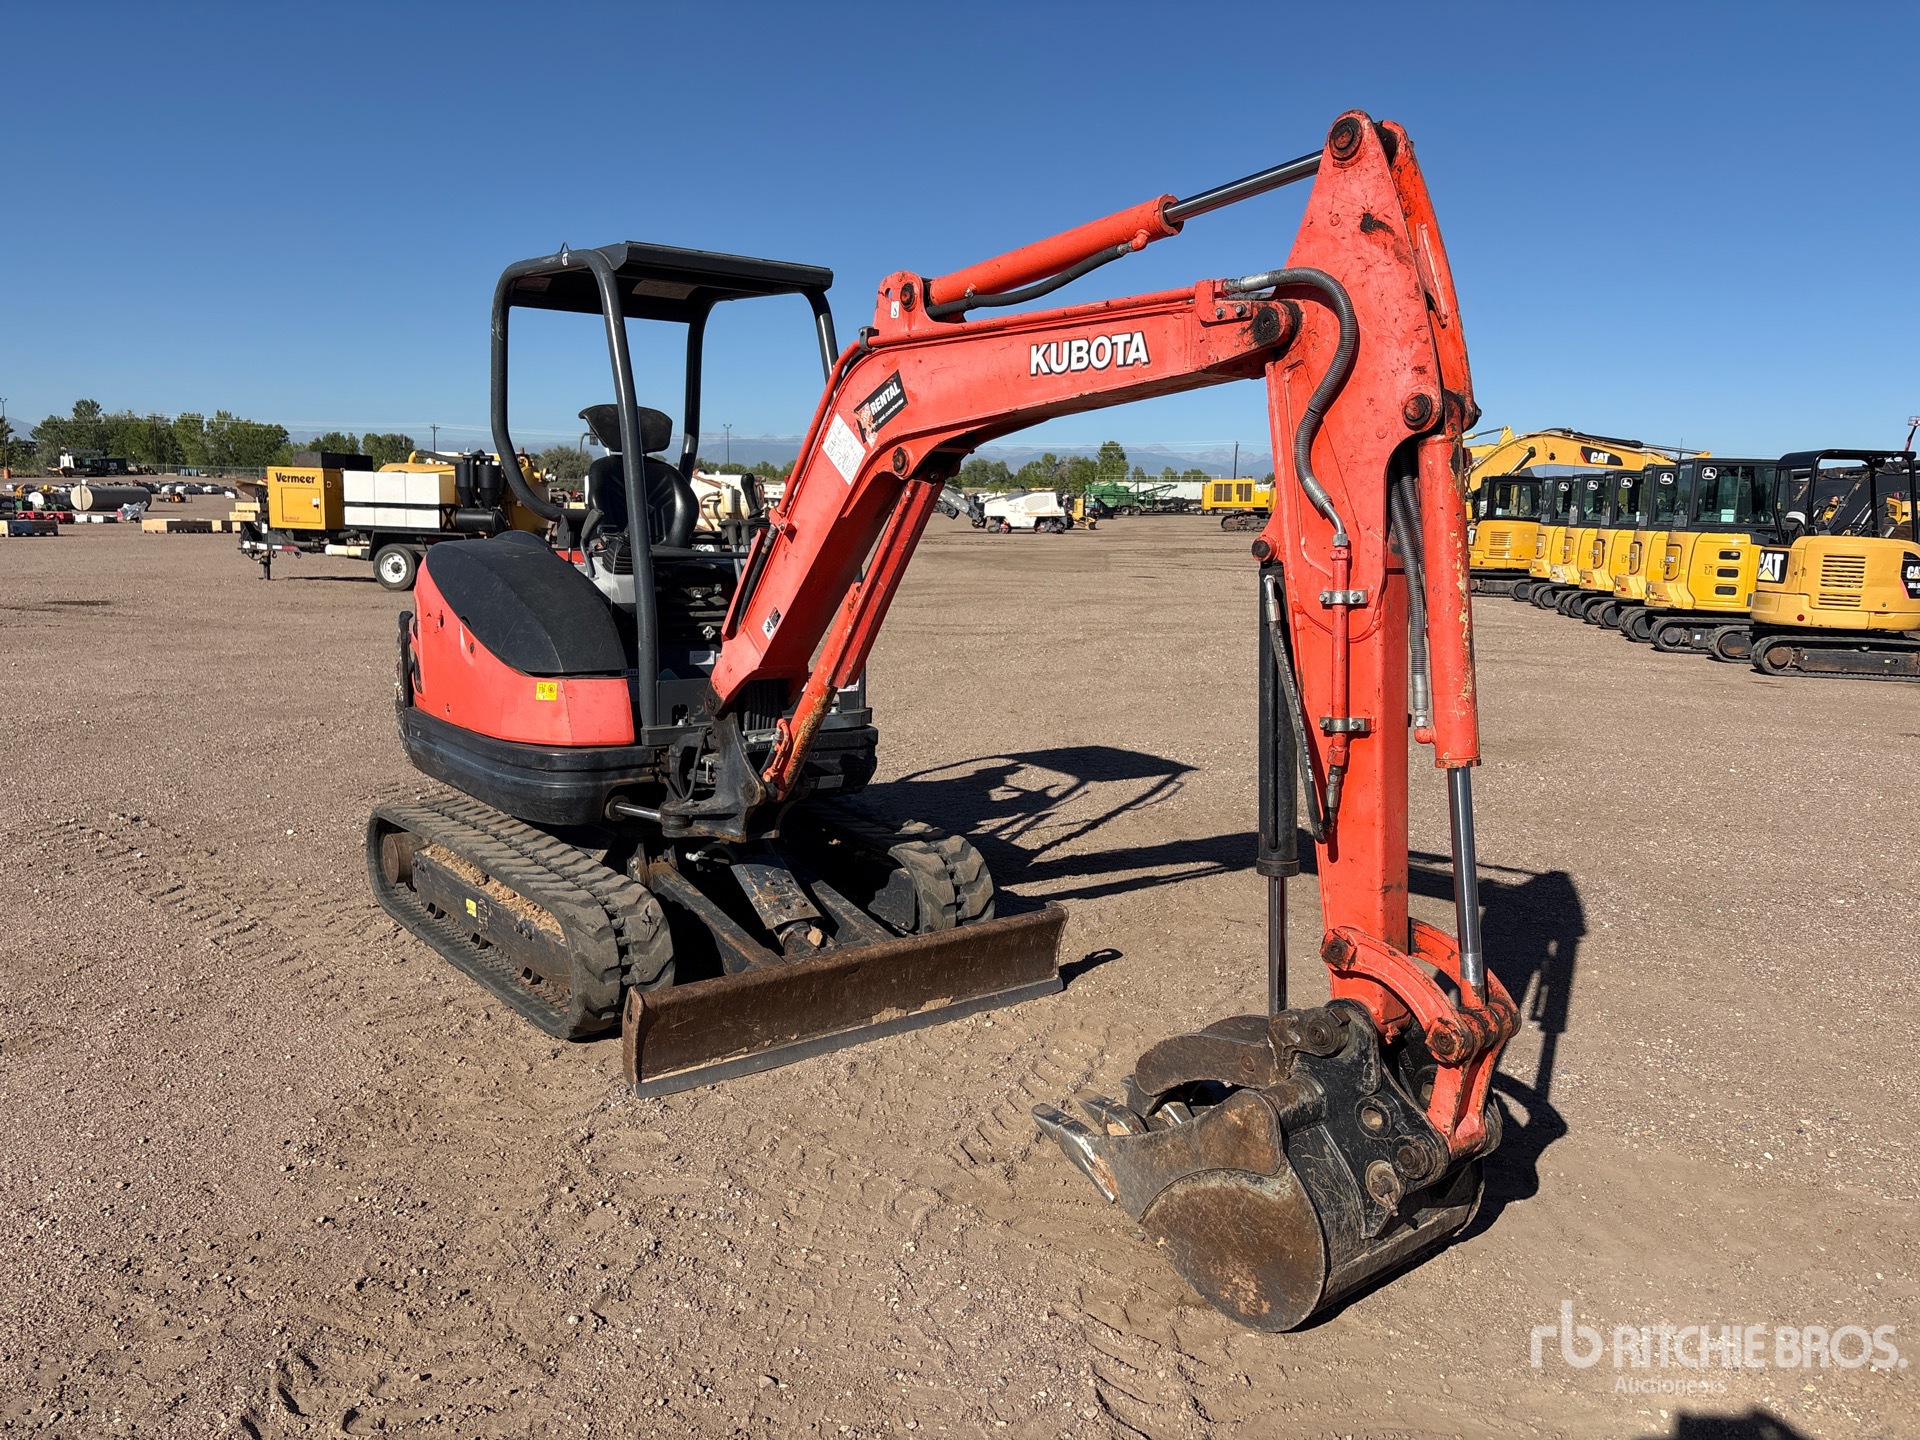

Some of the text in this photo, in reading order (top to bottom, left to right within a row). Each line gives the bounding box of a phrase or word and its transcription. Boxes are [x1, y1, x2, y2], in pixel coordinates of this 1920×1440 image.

[1030, 331, 1151, 376] KUBOTA
[870, 381, 901, 416] RENTAL
[1590, 451, 1610, 464] CAT
[275, 472, 316, 484] Vermeer
[1907, 565, 1920, 579] CA
